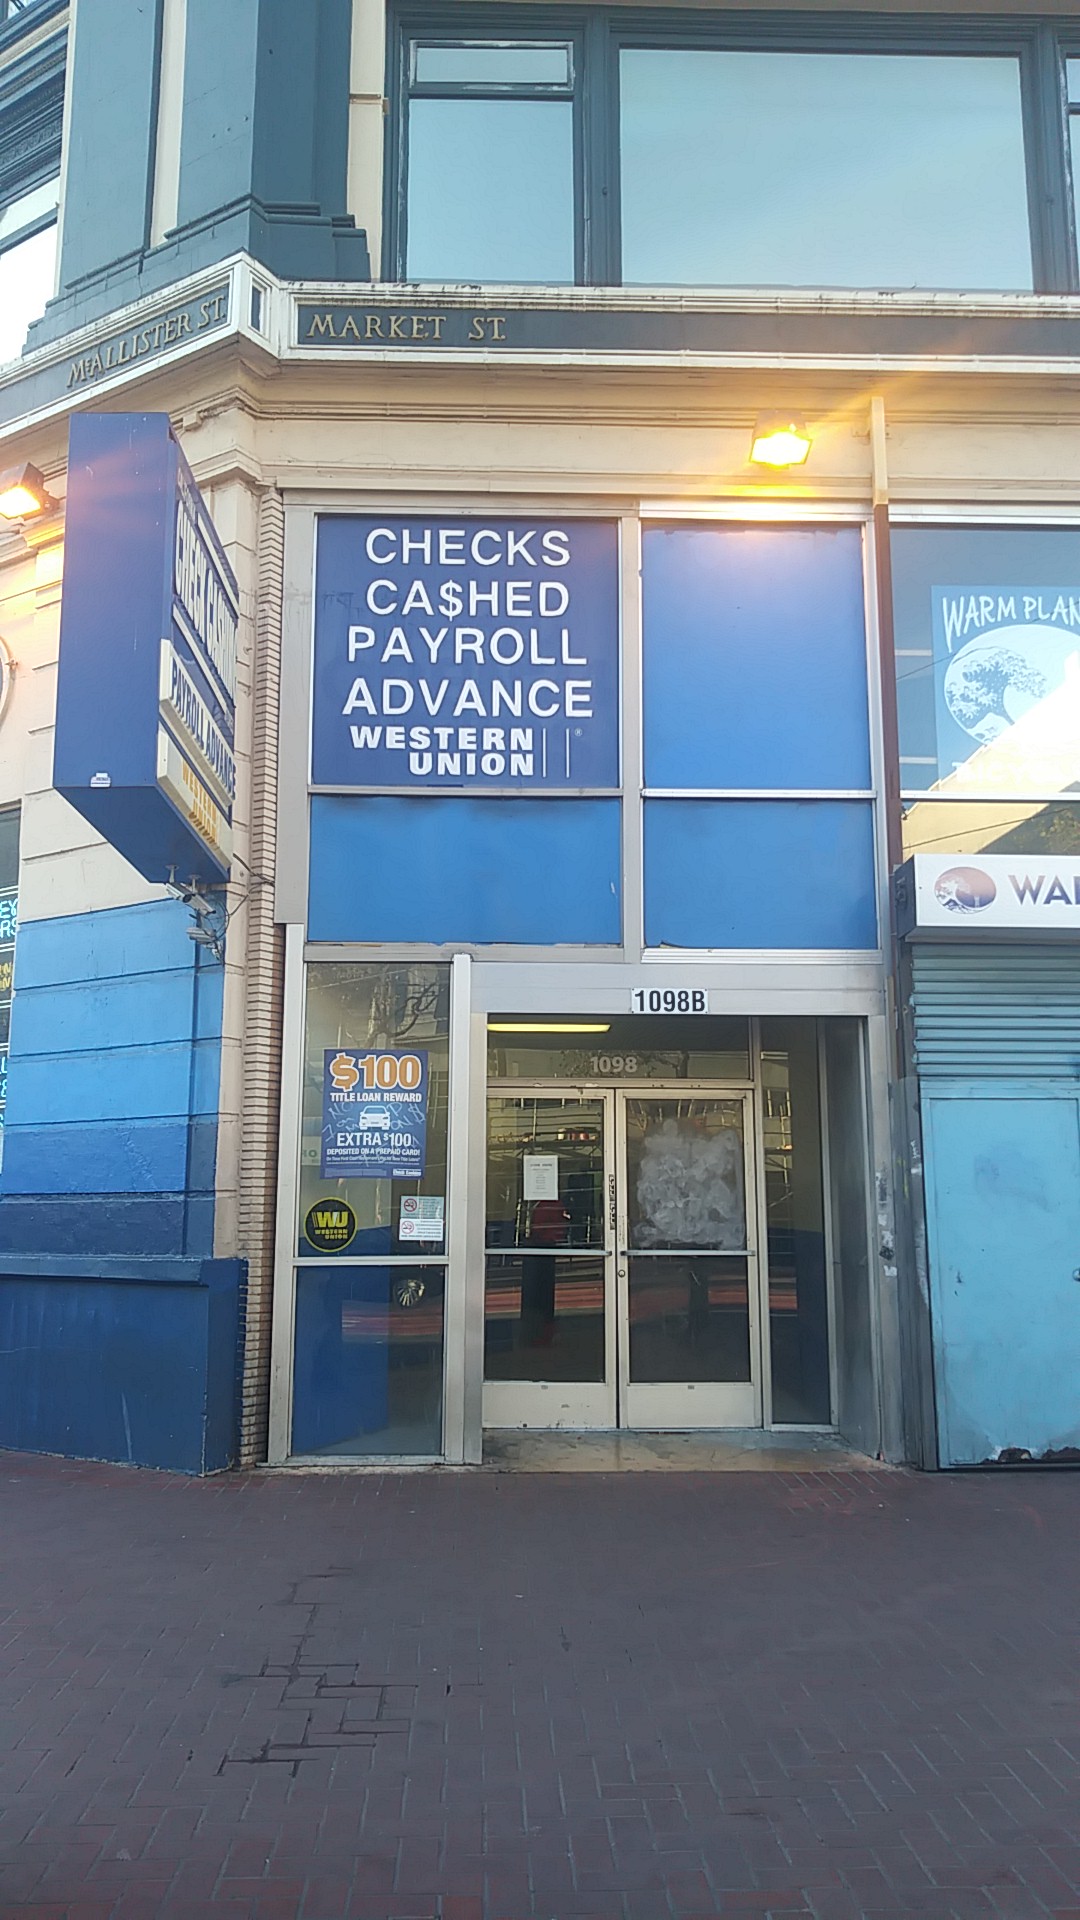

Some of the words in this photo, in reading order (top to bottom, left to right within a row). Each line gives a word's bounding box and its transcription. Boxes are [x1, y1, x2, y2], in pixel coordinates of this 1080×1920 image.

[198, 295, 226, 329] ST.
[307, 313, 447, 341] MARKET
[468, 316, 507, 341] ST.
[365, 528, 571, 567] CHECKS
[175, 499, 207, 645] CHECK
[366, 579, 570, 622] CA$HED
[942, 595, 1017, 653] WARM
[348, 626, 587, 665] PAYROLL
[342, 678, 593, 718] ADVANCE
[170, 655, 204, 750] PAYROLL
[205, 718, 237, 800] ADVANCE
[349, 725, 533, 751] WESTERN
[409, 752, 534, 776] UNION
[181, 757, 217, 822] WESTERN
[192, 798, 219, 843] UNION
[634, 989, 706, 1013] 1098B
[330, 1052, 423, 1092] $100
[590, 1055, 638, 1074] 1098
[330, 1092, 355, 1102] TITLE
[357, 1092, 380, 1102] LOAN
[383, 1092, 422, 1103] REWARD
[336, 1132, 382, 1147] EXTRA
[383, 1132, 412, 1147] $100
[312, 1211, 349, 1228] WU
